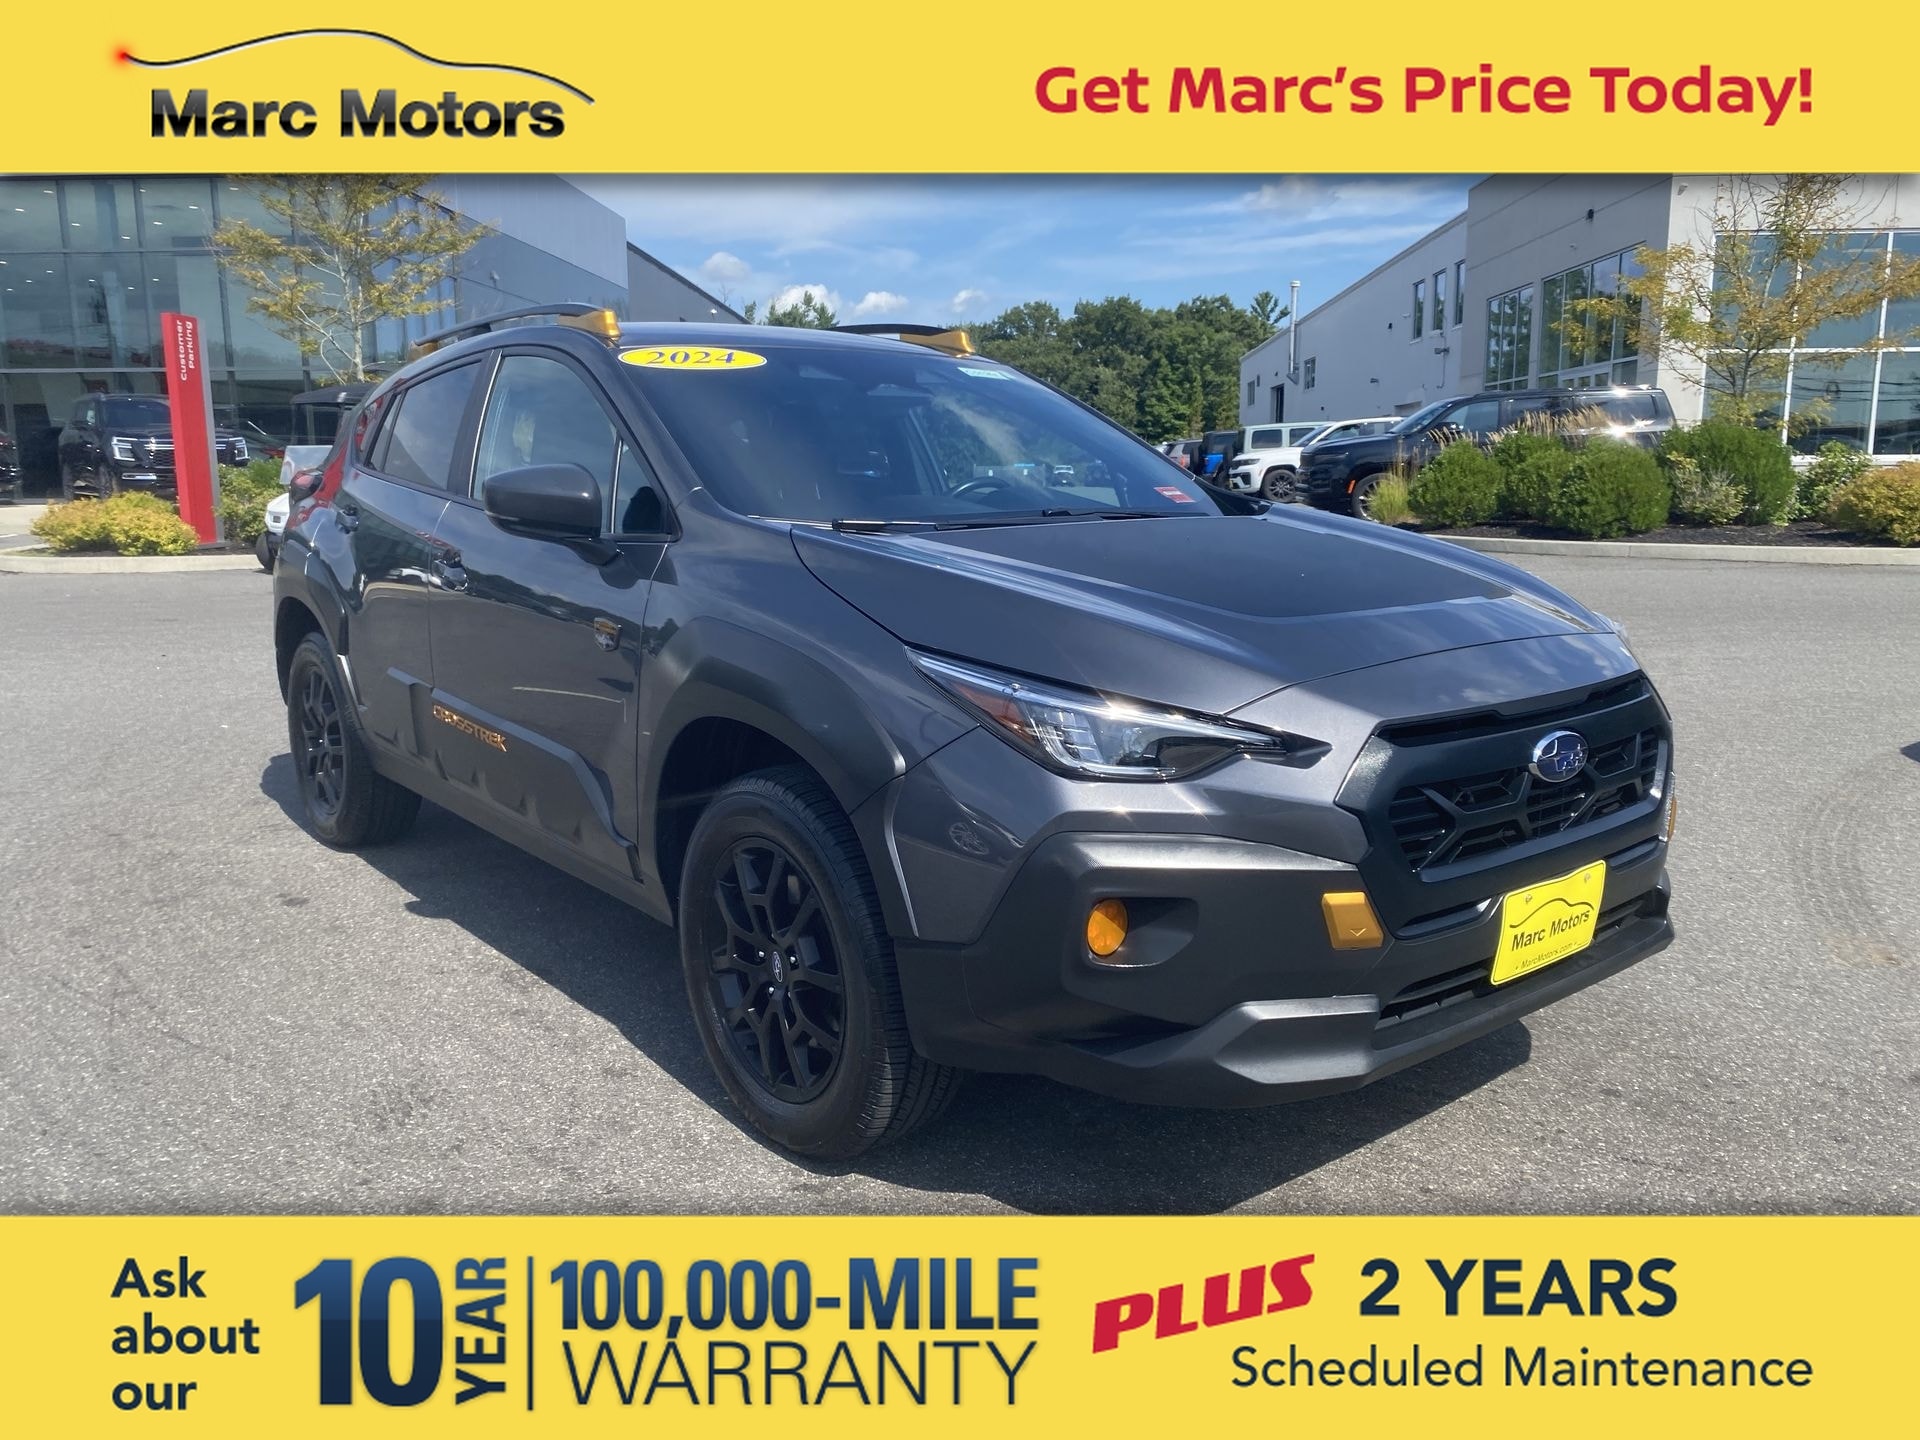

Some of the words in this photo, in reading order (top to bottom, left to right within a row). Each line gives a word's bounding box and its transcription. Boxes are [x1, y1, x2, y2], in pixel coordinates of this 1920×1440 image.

[176, 319, 187, 381] Customer
[185, 320, 195, 369] Parking
[646, 350, 735, 364] 2024
[433, 704, 507, 752] CROSSTREK
[1511, 927, 1546, 952] Marc
[1549, 909, 1590, 938] Motors
